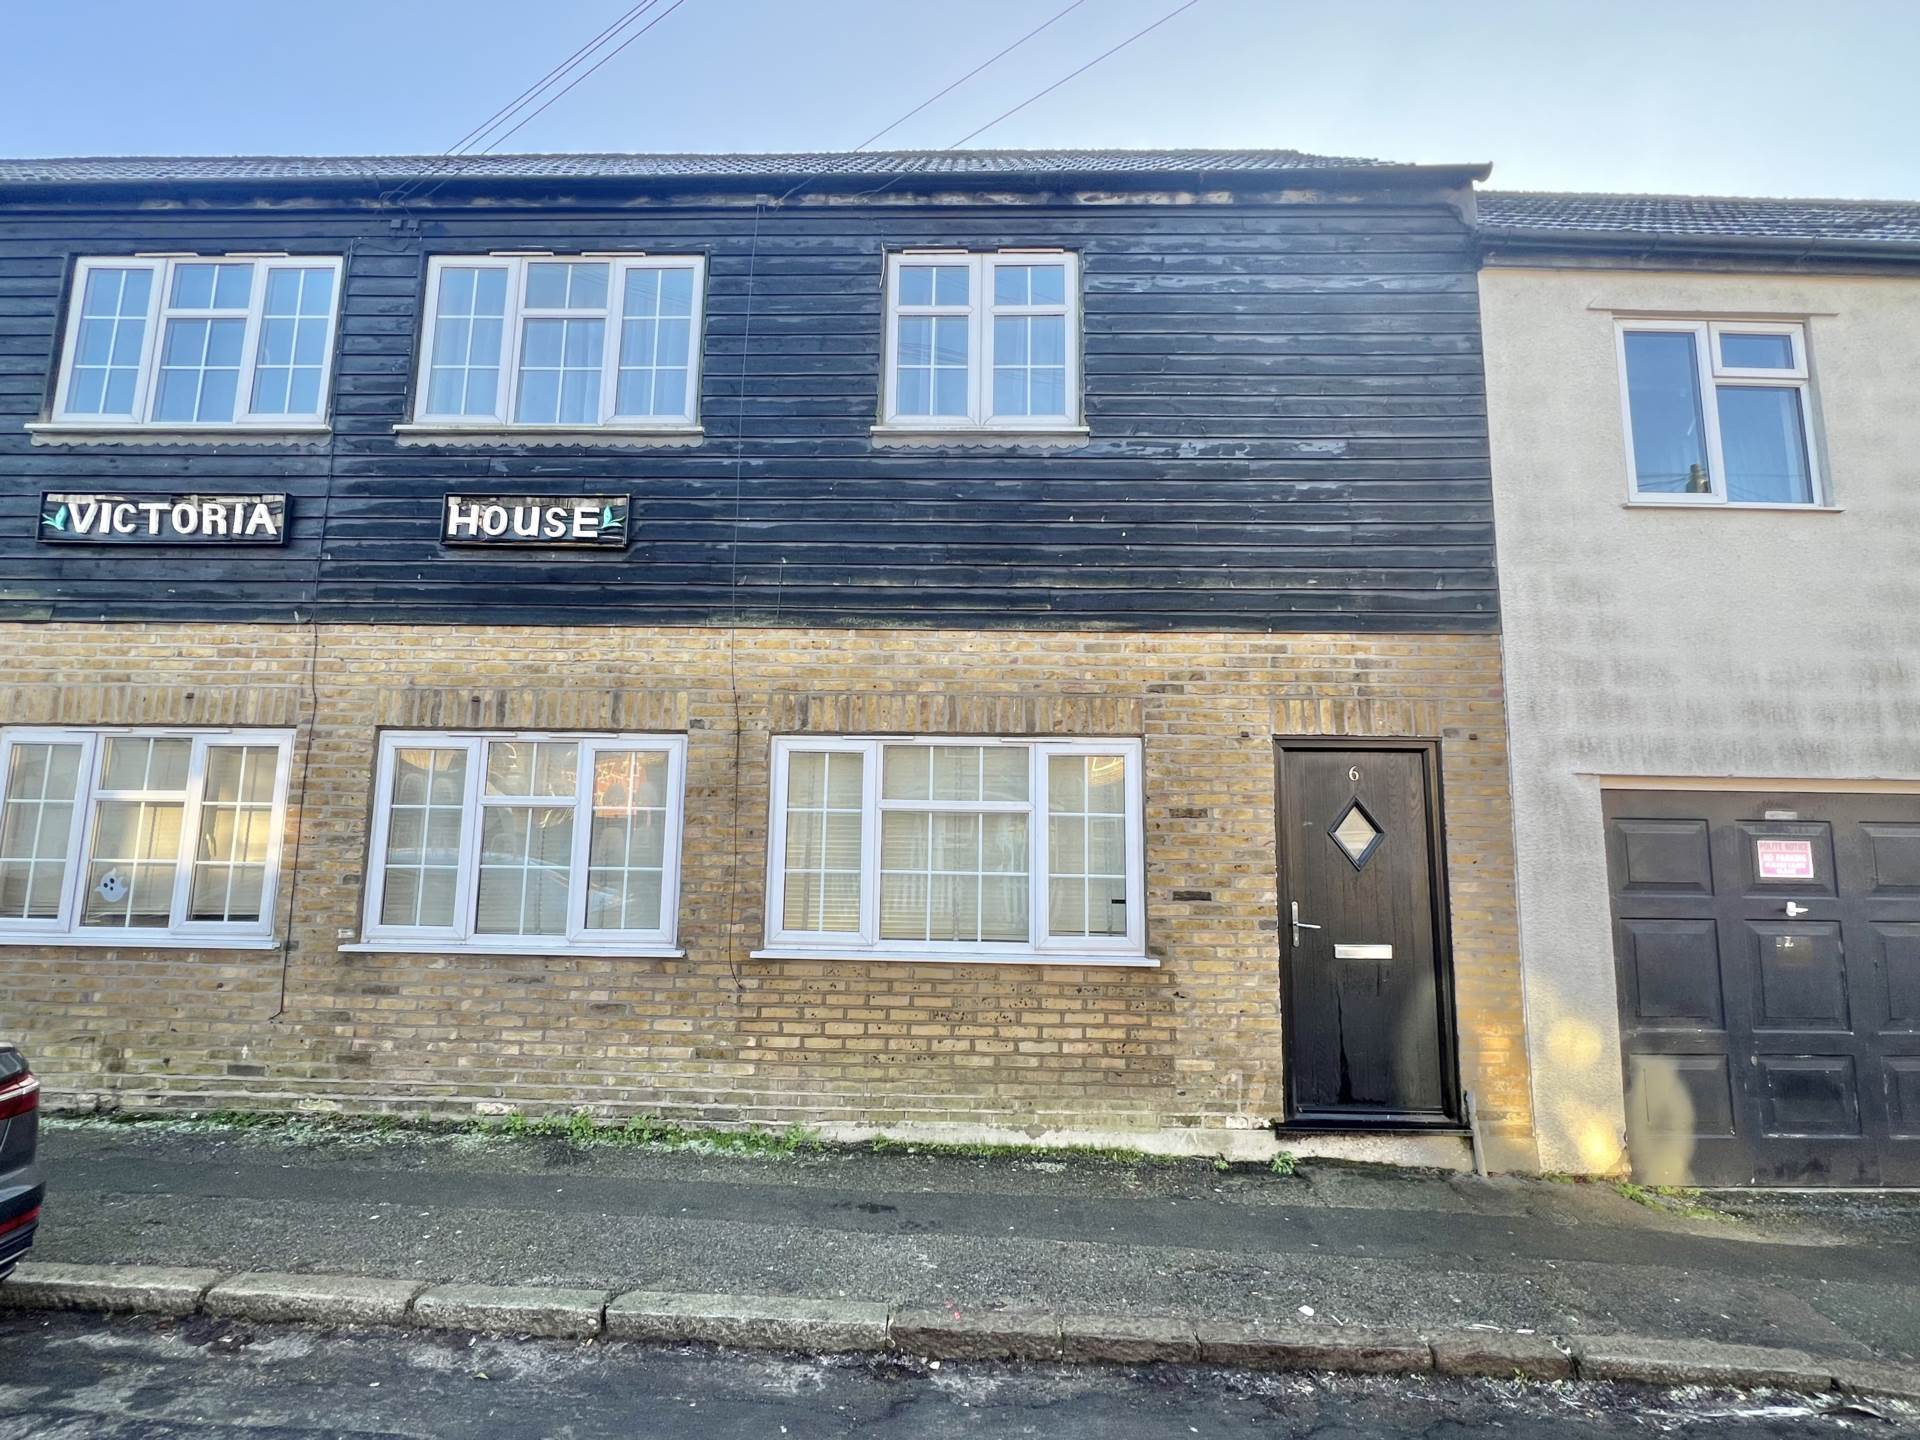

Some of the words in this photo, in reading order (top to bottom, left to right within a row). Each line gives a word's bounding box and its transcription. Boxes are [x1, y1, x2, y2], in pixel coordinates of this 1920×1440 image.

[68, 502, 278, 535] VICTORIA
[447, 504, 600, 538] HOUSE
[1348, 765, 1360, 781] 6
